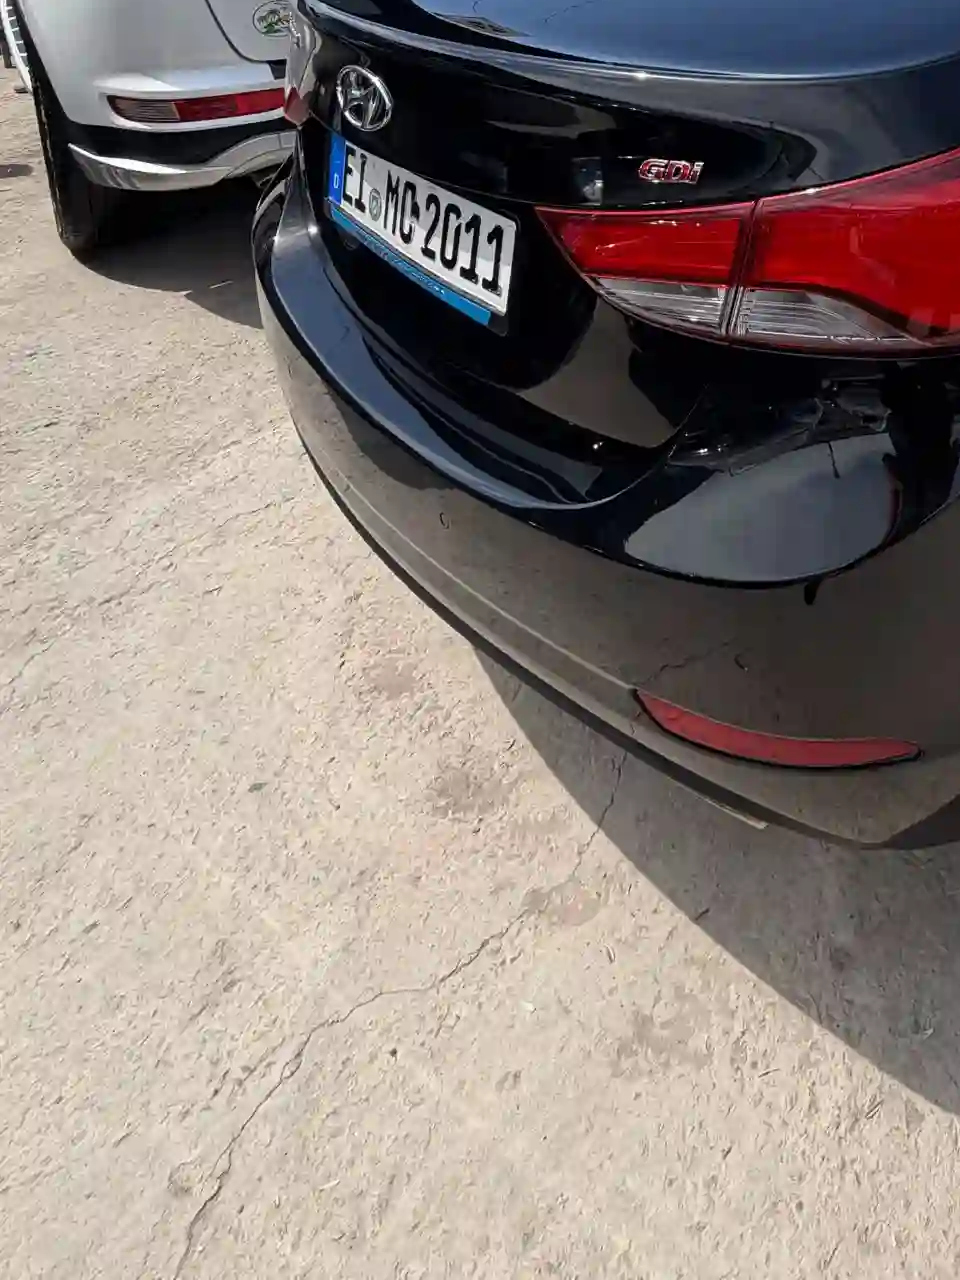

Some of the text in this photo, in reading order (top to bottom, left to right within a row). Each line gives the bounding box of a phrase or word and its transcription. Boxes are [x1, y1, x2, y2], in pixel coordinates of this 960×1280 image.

[333, 173, 340, 189] D
[345, 146, 368, 214] EI
[420, 193, 504, 298] 2011
